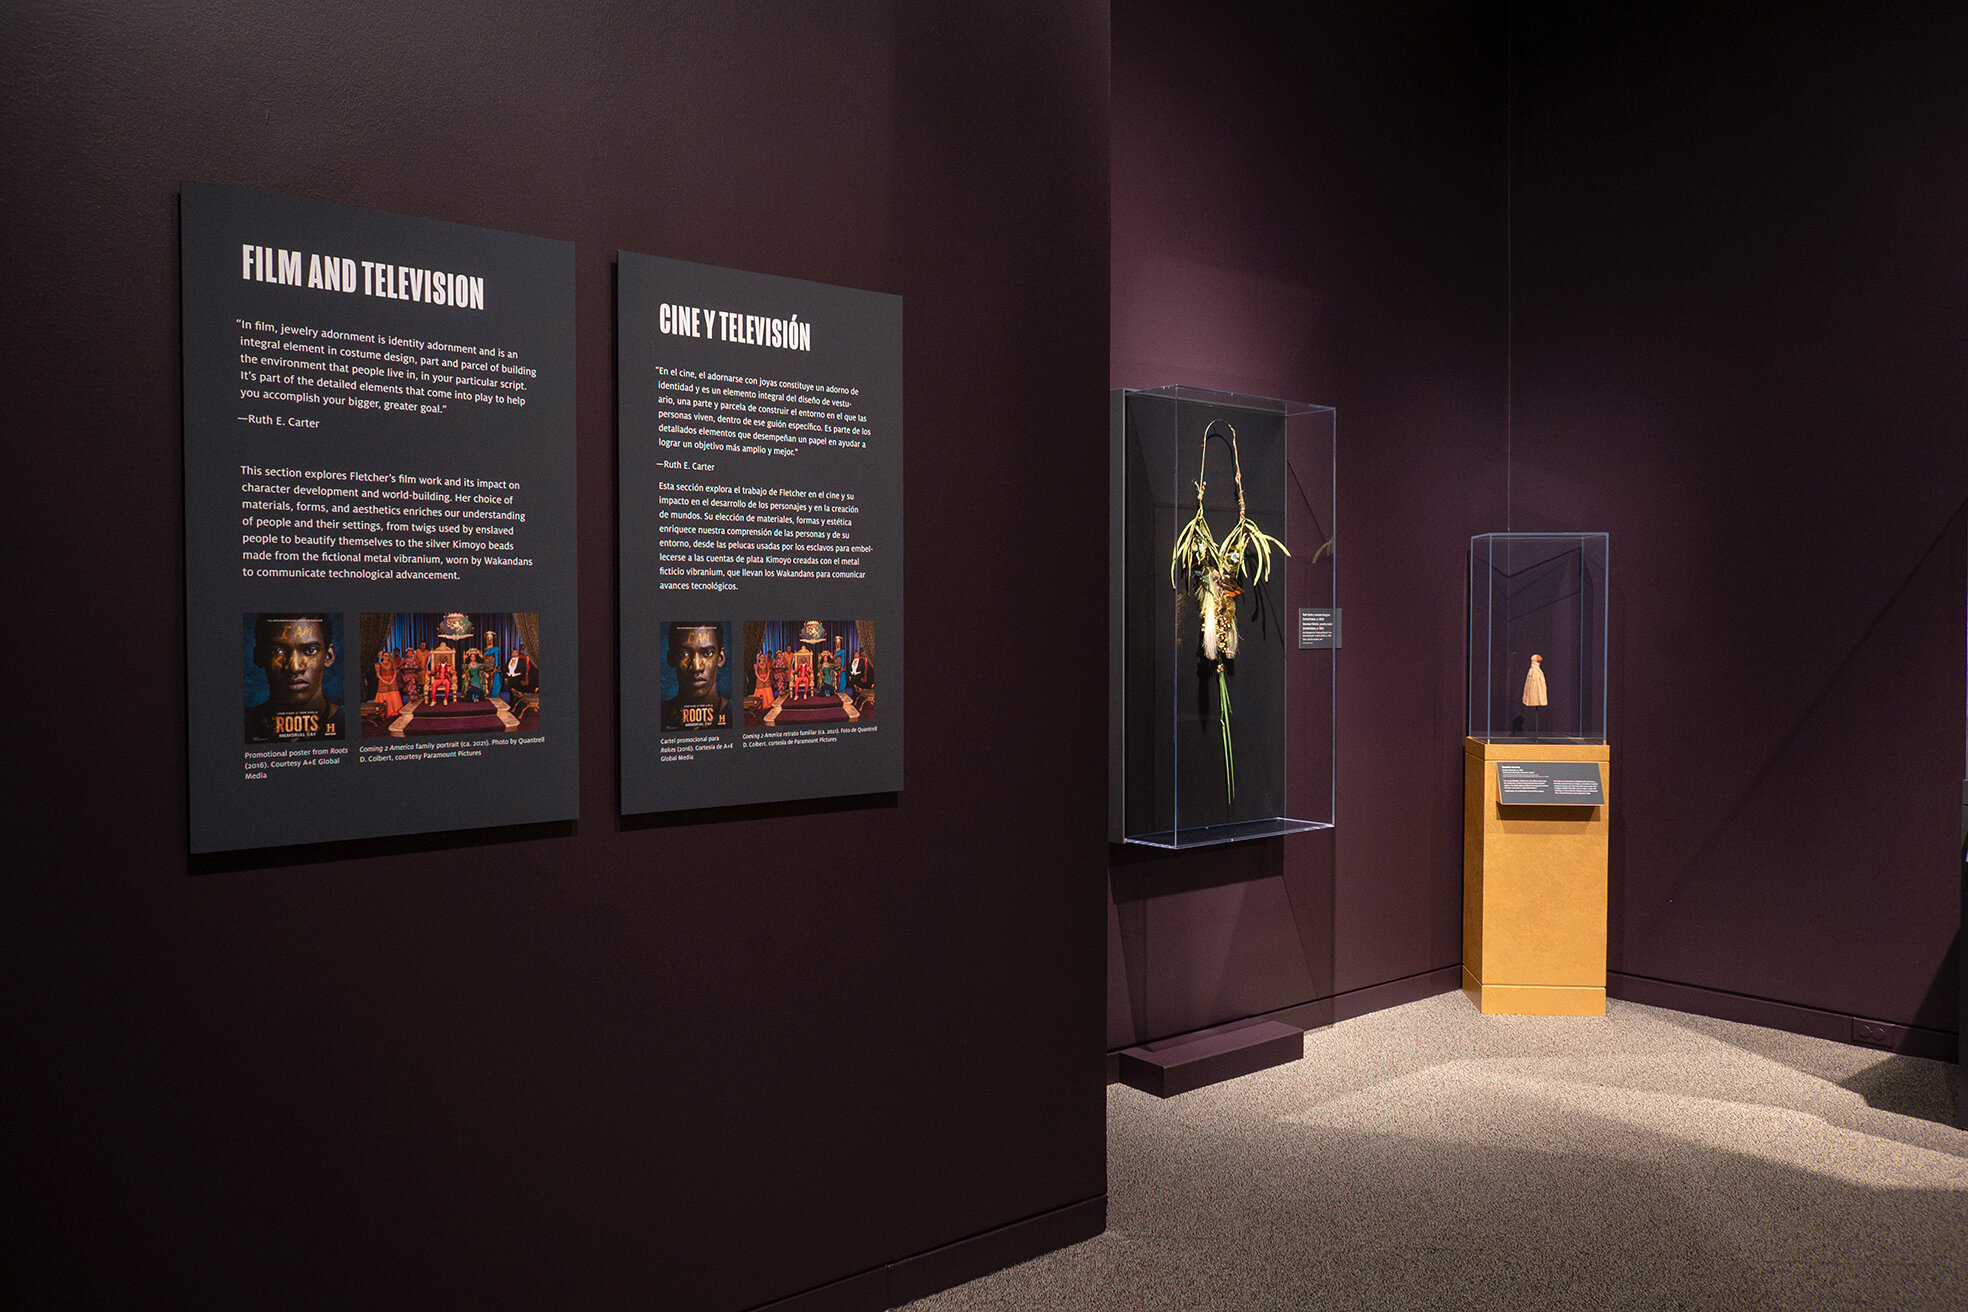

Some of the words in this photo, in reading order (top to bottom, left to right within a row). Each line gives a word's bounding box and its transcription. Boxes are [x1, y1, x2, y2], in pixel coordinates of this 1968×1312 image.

[243, 244, 302, 287] FILM
[308, 254, 356, 293] AND
[361, 261, 484, 310] TELEVISION
[659, 303, 700, 338] CINE
[703, 309, 716, 340] Y
[718, 311, 810, 351] TELEVISIÓN
[254, 321, 278, 334] film,
[280, 324, 318, 339] jewelry
[321, 329, 375, 343] adornment
[378, 334, 386, 345] is
[388, 336, 424, 350] identity
[427, 341, 477, 355] adornment
[478, 348, 496, 357] and
[498, 348, 505, 358] is
[507, 351, 518, 359] an
[240, 336, 280, 350] integral
[283, 341, 325, 354] element
[327, 345, 337, 355] in
[339, 349, 381, 360] costume
[383, 352, 418, 365] design,
[421, 357, 439, 366] part
[441, 359, 458, 368] and
[461, 361, 488, 371] parcel
[490, 363, 499, 372] of
[501, 364, 536, 378] building
[240, 354, 257, 364] the
[260, 357, 326, 371] environment
[328, 362, 349, 373] that
[351, 366, 385, 377] people
[387, 368, 404, 378] live
[406, 370, 418, 381] in,
[421, 371, 429, 380] in
[432, 374, 453, 383] your
[455, 376, 498, 387] particular
[500, 380, 527, 391] script.
[670, 368, 677, 376] el
[678, 369, 697, 379] cine,
[698, 371, 706, 379] el
[707, 372, 743, 384] adornarse
[744, 377, 758, 385] con
[758, 377, 777, 388] joyas
[778, 381, 814, 392] constituye
[825, 385, 849, 395] adorno
[850, 388, 859, 396] de
[240, 389, 260, 399] you
[263, 391, 320, 403] accomplish
[323, 397, 346, 406] your
[348, 397, 381, 409] bigger,
[383, 402, 418, 411] greater
[260, 374, 281, 383] part
[284, 375, 294, 384] of
[297, 376, 314, 386] the
[316, 378, 356, 390] detailed
[359, 382, 403, 394] elements
[405, 386, 425, 396] that
[427, 390, 452, 399] come
[454, 390, 472, 401] into
[475, 392, 493, 404] play
[495, 395, 504, 404] to
[506, 395, 526, 407] help
[658, 380, 694, 392] identidad
[695, 386, 700, 394] y
[722, 388, 757, 399] elemento
[758, 391, 784, 402] integral
[785, 394, 797, 402] del
[797, 395, 821, 405] diseño
[821, 398, 830, 406] de
[831, 400, 852, 408] vestu-
[276, 416, 285, 426] E.
[288, 417, 319, 428] Carter
[683, 461, 690, 470] E.
[691, 462, 715, 471] Carter
[240, 466, 262, 476] This
[265, 468, 302, 478] section
[305, 470, 347, 480] explores
[398, 474, 416, 484] film
[418, 476, 442, 486] work
[444, 478, 461, 487] and
[463, 478, 475, 487] its
[477, 479, 506, 490] impact
[508, 482, 520, 490] on
[242, 483, 290, 494] character
[293, 485, 359, 497] development
[361, 489, 379, 498] and
[382, 490, 452, 504] world-building.
[455, 494, 471, 503] Her
[473, 494, 502, 504] choice
[503, 496, 513, 505] of
[658, 482, 675, 491] Esta
[676, 483, 704, 492] sección
[705, 485, 732, 494] explora
[733, 486, 740, 494] el
[742, 487, 767, 497] trabajo
[768, 488, 778, 496] de
[779, 488, 807, 498] Fletcher
[818, 491, 825, 499] el
[825, 491, 840, 500] cine
[242, 500, 293, 512] materials,
[296, 501, 328, 513] forms,
[331, 504, 350, 513] and
[352, 505, 401, 515] aesthetics
[403, 507, 443, 517] enriches
[445, 510, 460, 518] our
[462, 510, 526, 523] understanding
[691, 582, 738, 592] tecnológicos.
[276, 715, 319, 733] ROOTS
[682, 707, 714, 722] ROOTS
[518, 736, 545, 745] Quantrell
[244, 750, 287, 758] Promotional
[423, 751, 456, 759] Paramount
[244, 762, 269, 770] (2016).
